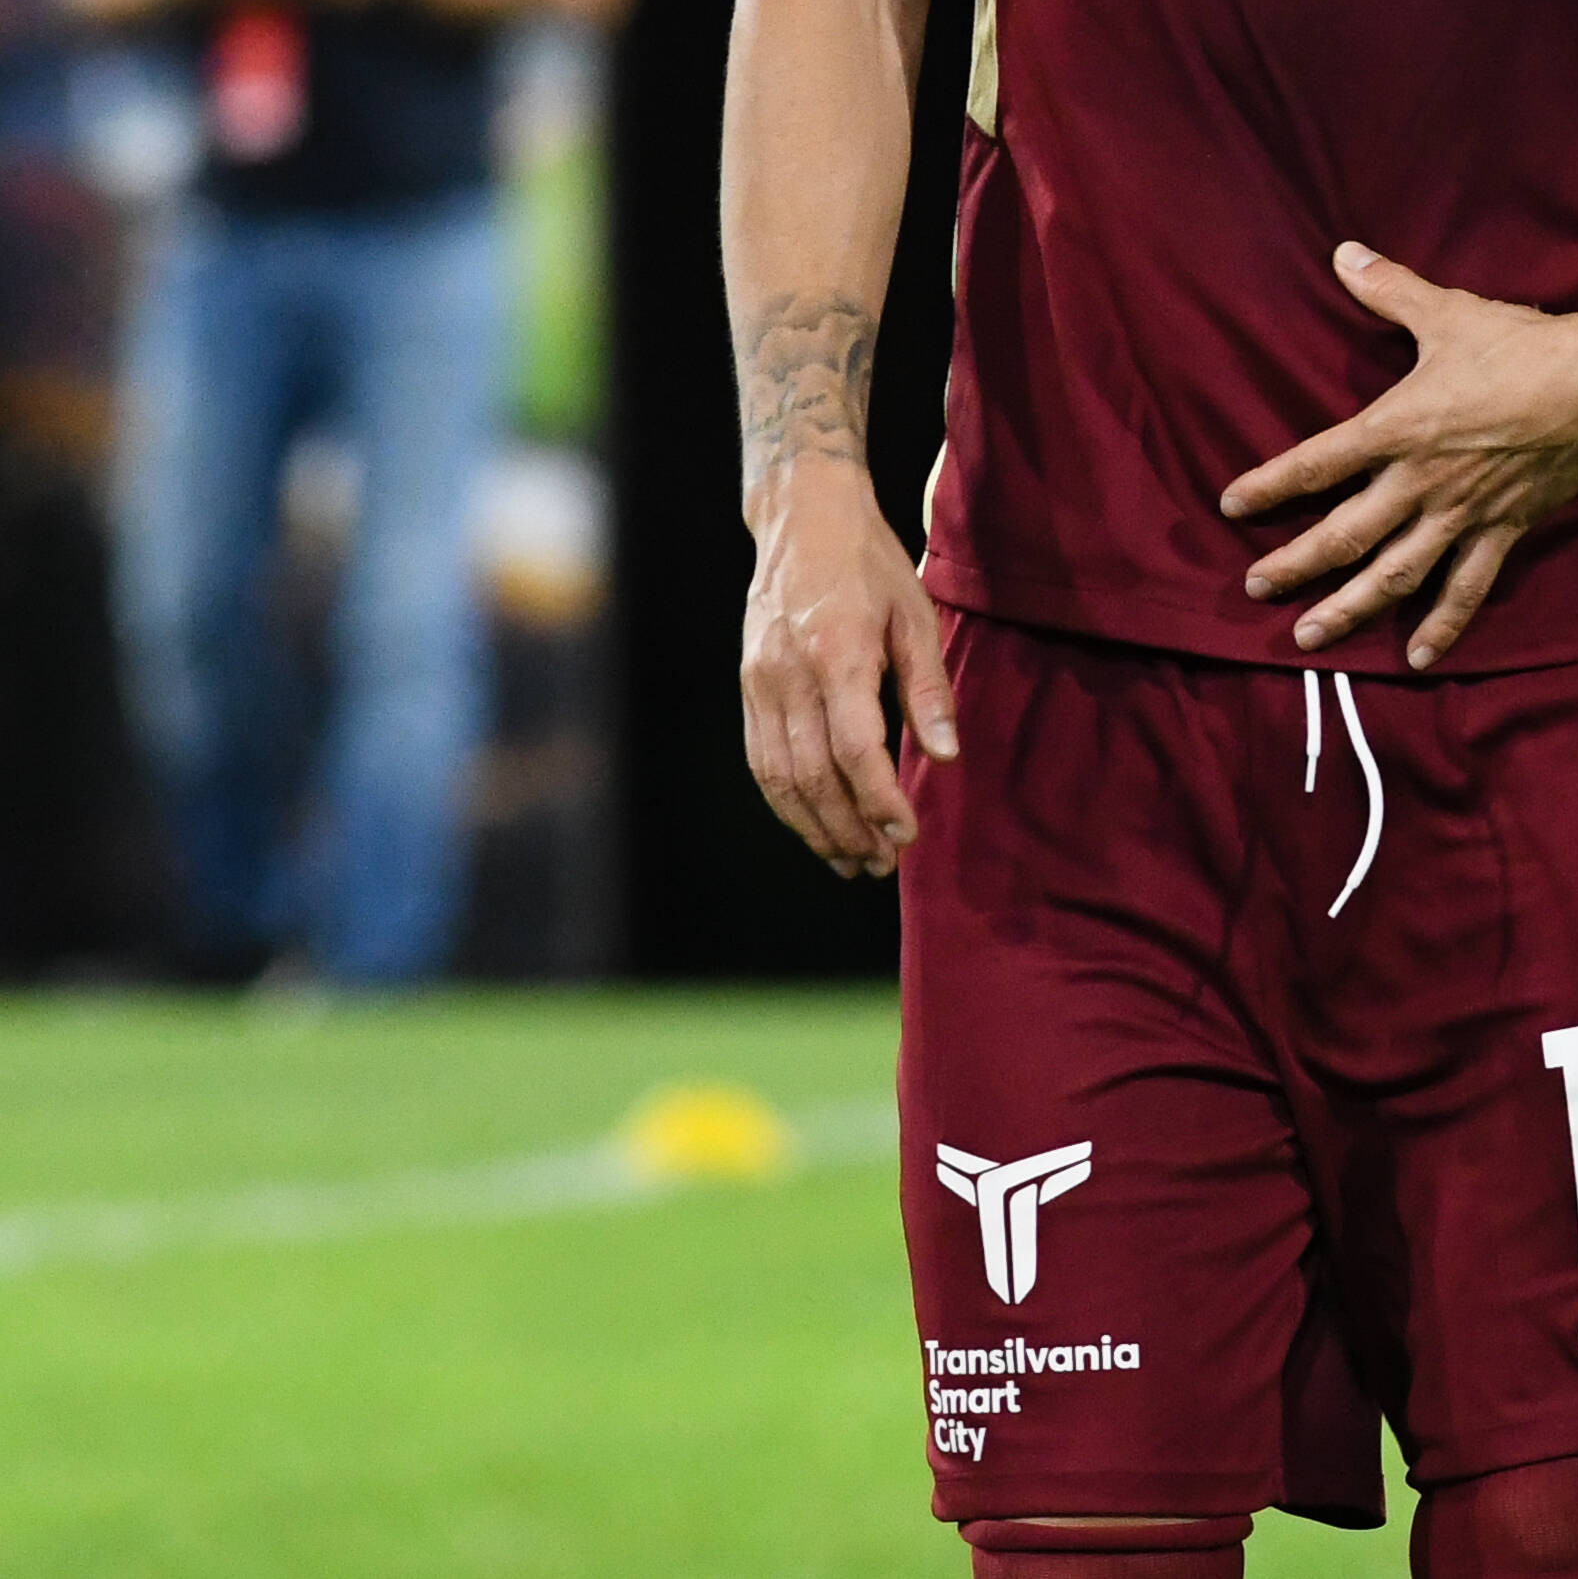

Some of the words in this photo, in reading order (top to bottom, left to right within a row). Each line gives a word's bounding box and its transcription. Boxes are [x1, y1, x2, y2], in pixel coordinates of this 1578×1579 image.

[925, 1334, 1140, 1375] Transilvania
[929, 1379, 1022, 1414] Smart
[934, 1418, 987, 1462] City
